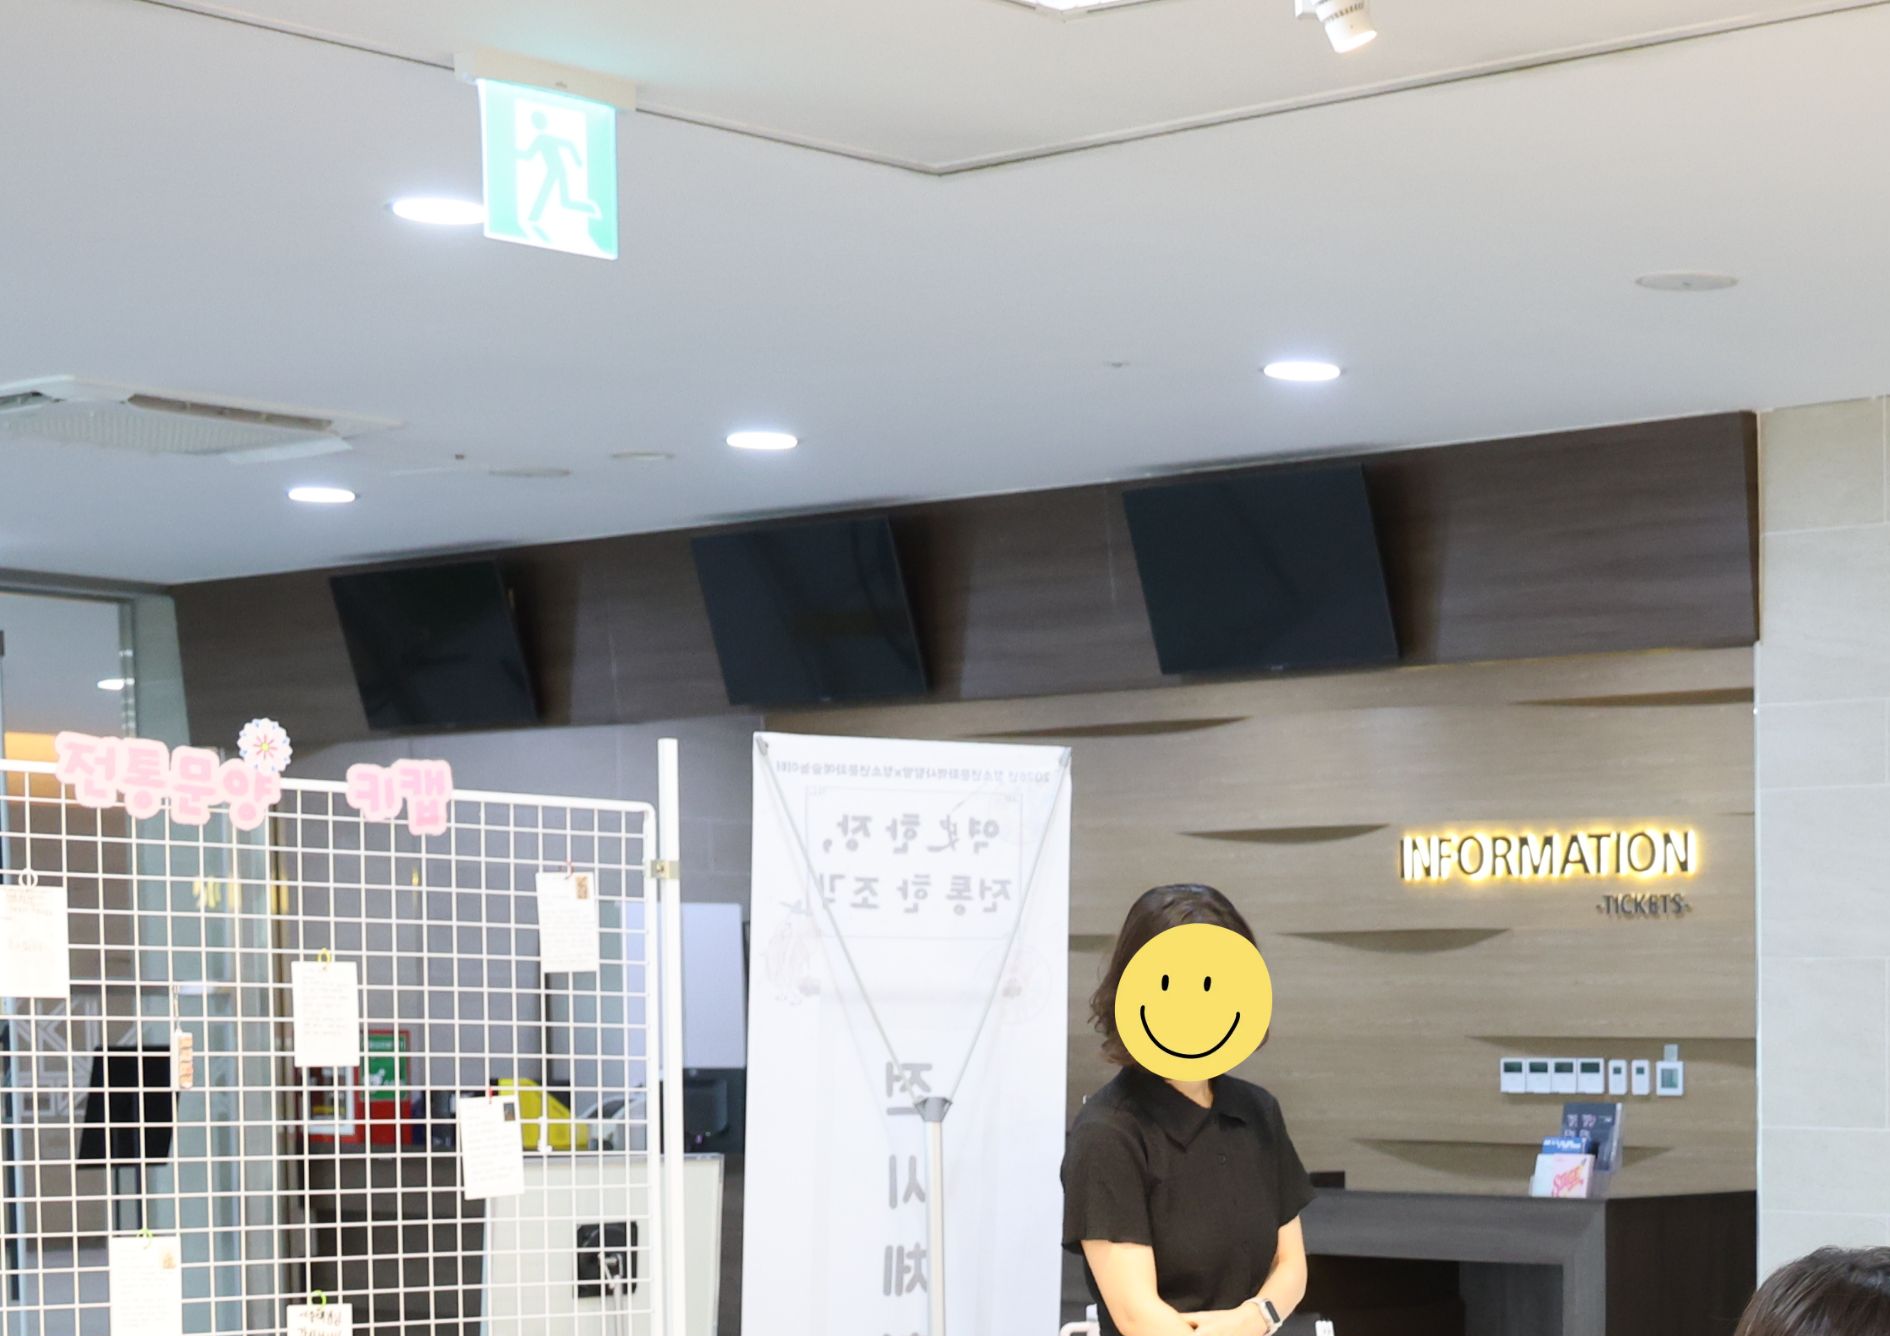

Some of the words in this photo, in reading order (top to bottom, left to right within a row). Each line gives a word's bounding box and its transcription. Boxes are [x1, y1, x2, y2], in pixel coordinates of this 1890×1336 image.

[58, 734, 279, 828] 전통문양
[348, 760, 451, 834] 키캡
[1400, 830, 1691, 879] INFORMATION
